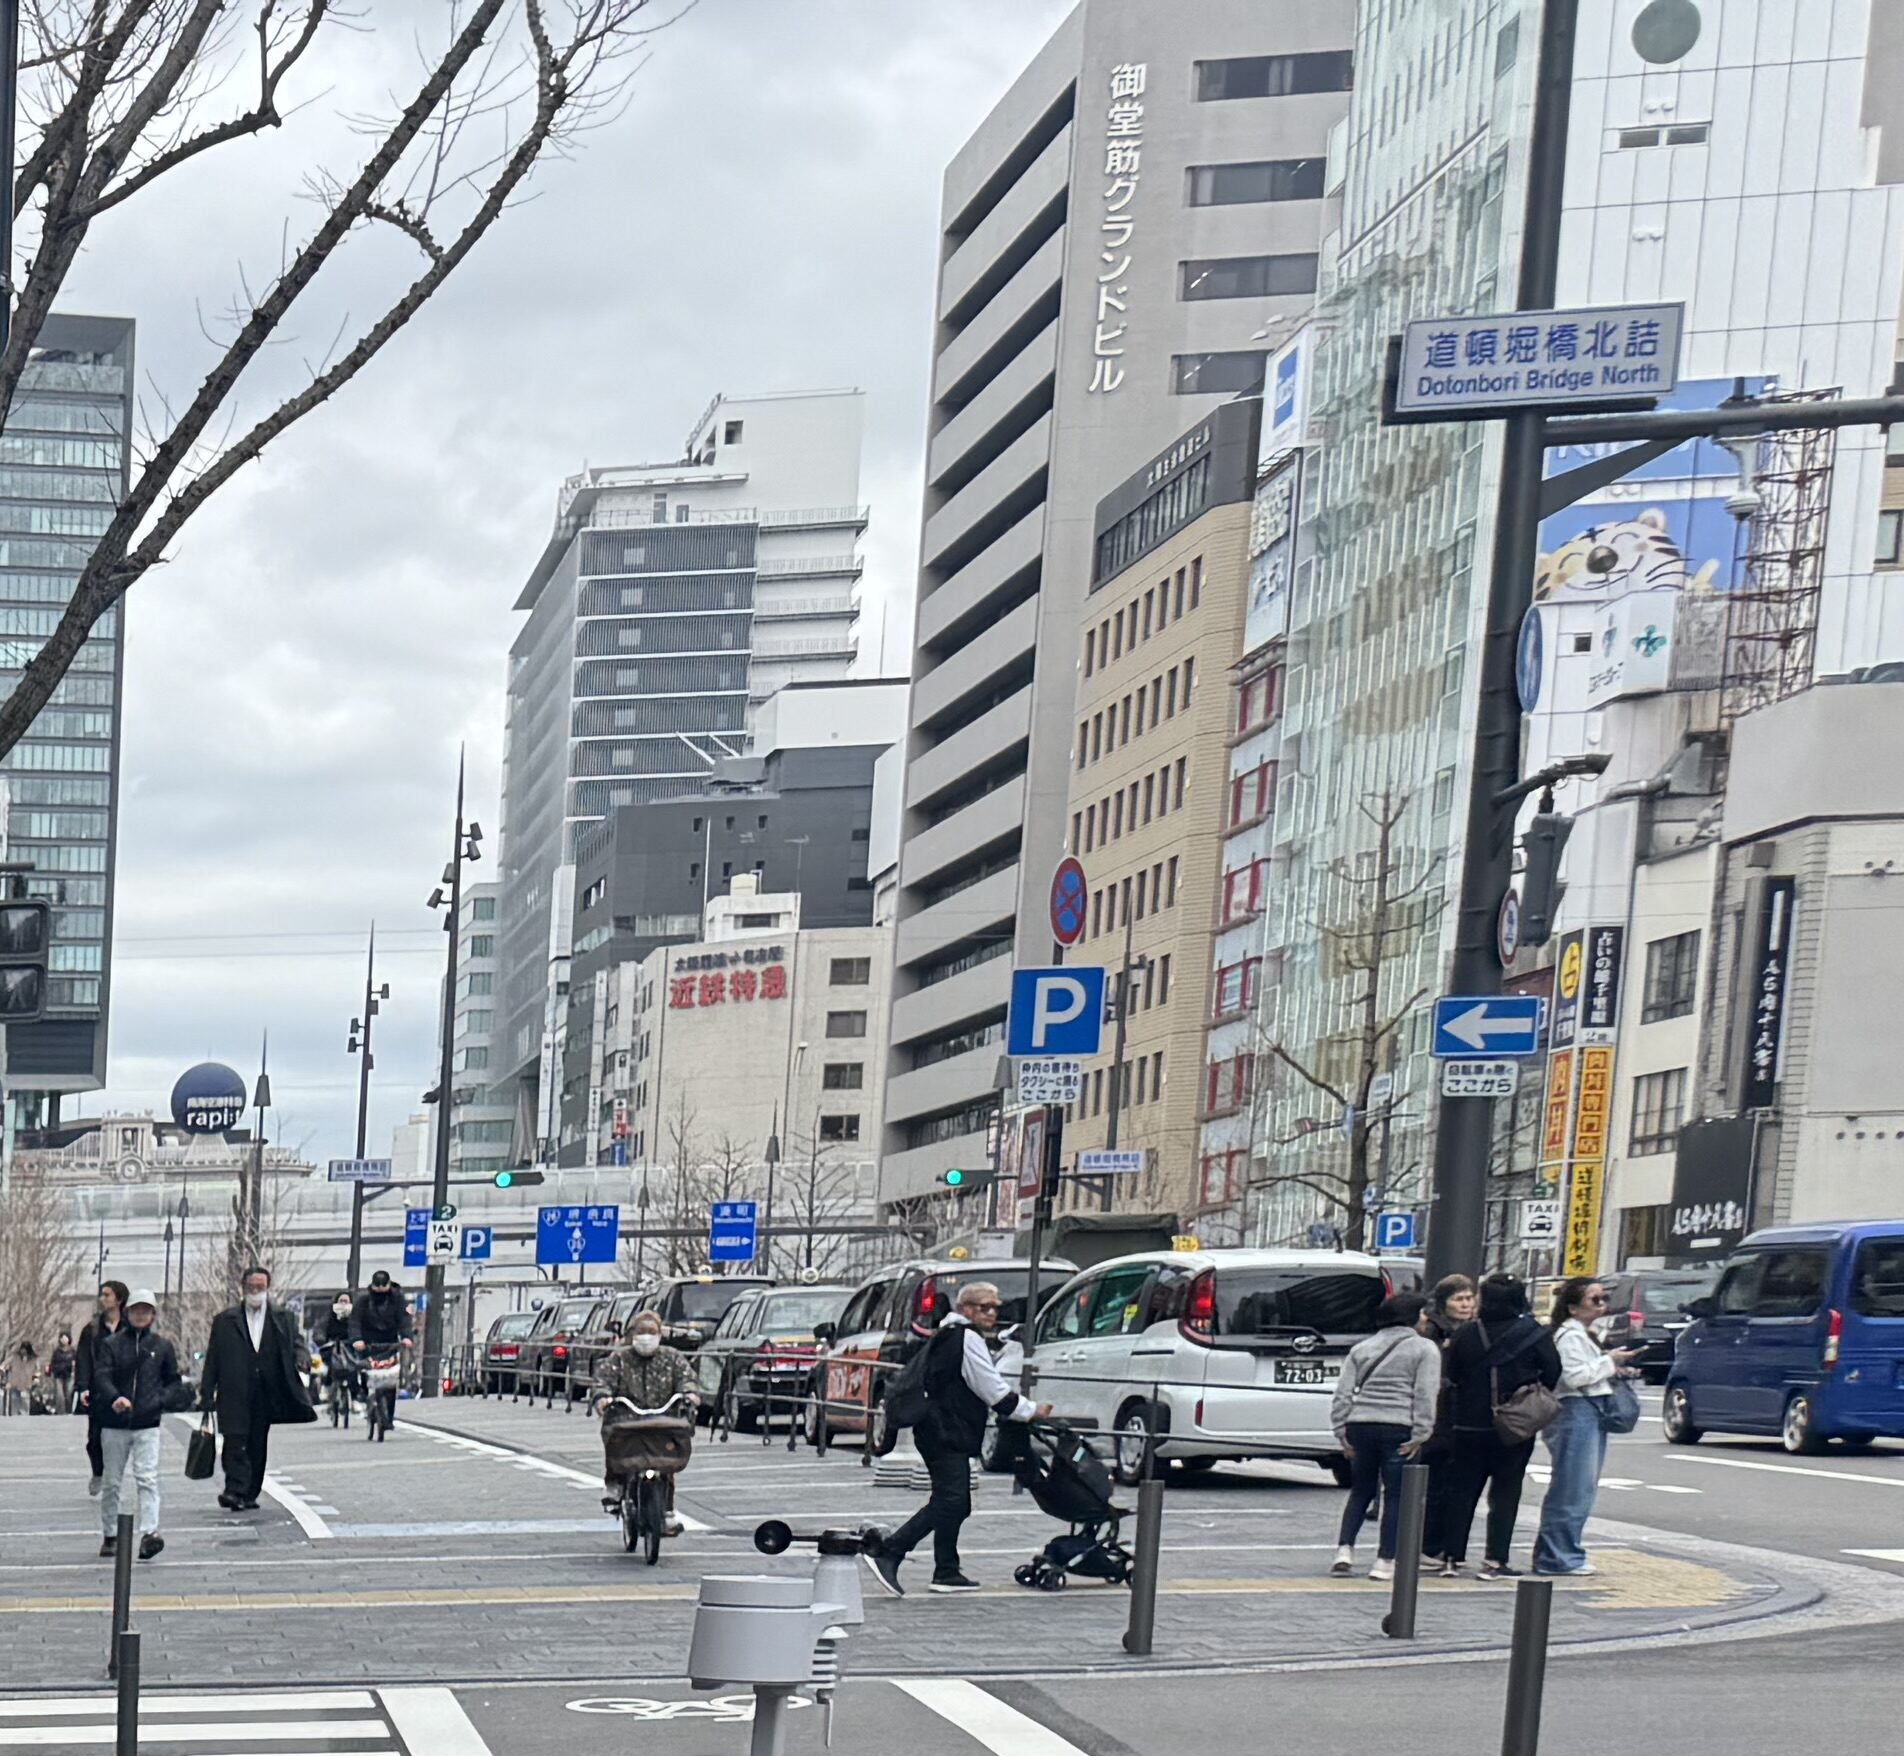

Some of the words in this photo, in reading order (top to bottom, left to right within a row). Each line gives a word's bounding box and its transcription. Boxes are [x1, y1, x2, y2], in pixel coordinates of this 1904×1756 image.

[1089, 63, 1147, 393] 御堂筋グランドビル
[1424, 320, 1660, 369] 道頓堀橋北詰
[1417, 371, 1519, 397] Dotonbori
[1526, 368, 1592, 391] Bridge
[1602, 364, 1659, 387] North
[1032, 977, 1086, 1048] P
[1021, 1088, 1077, 1101] ここから
[1447, 1078, 1512, 1094] ここから
[442, 1205, 452, 1219] 2
[1527, 1203, 1559, 1213] TAXI
[433, 1223, 458, 1233] TAXI
[1386, 1219, 1406, 1243] P
[466, 1230, 486, 1257] P
